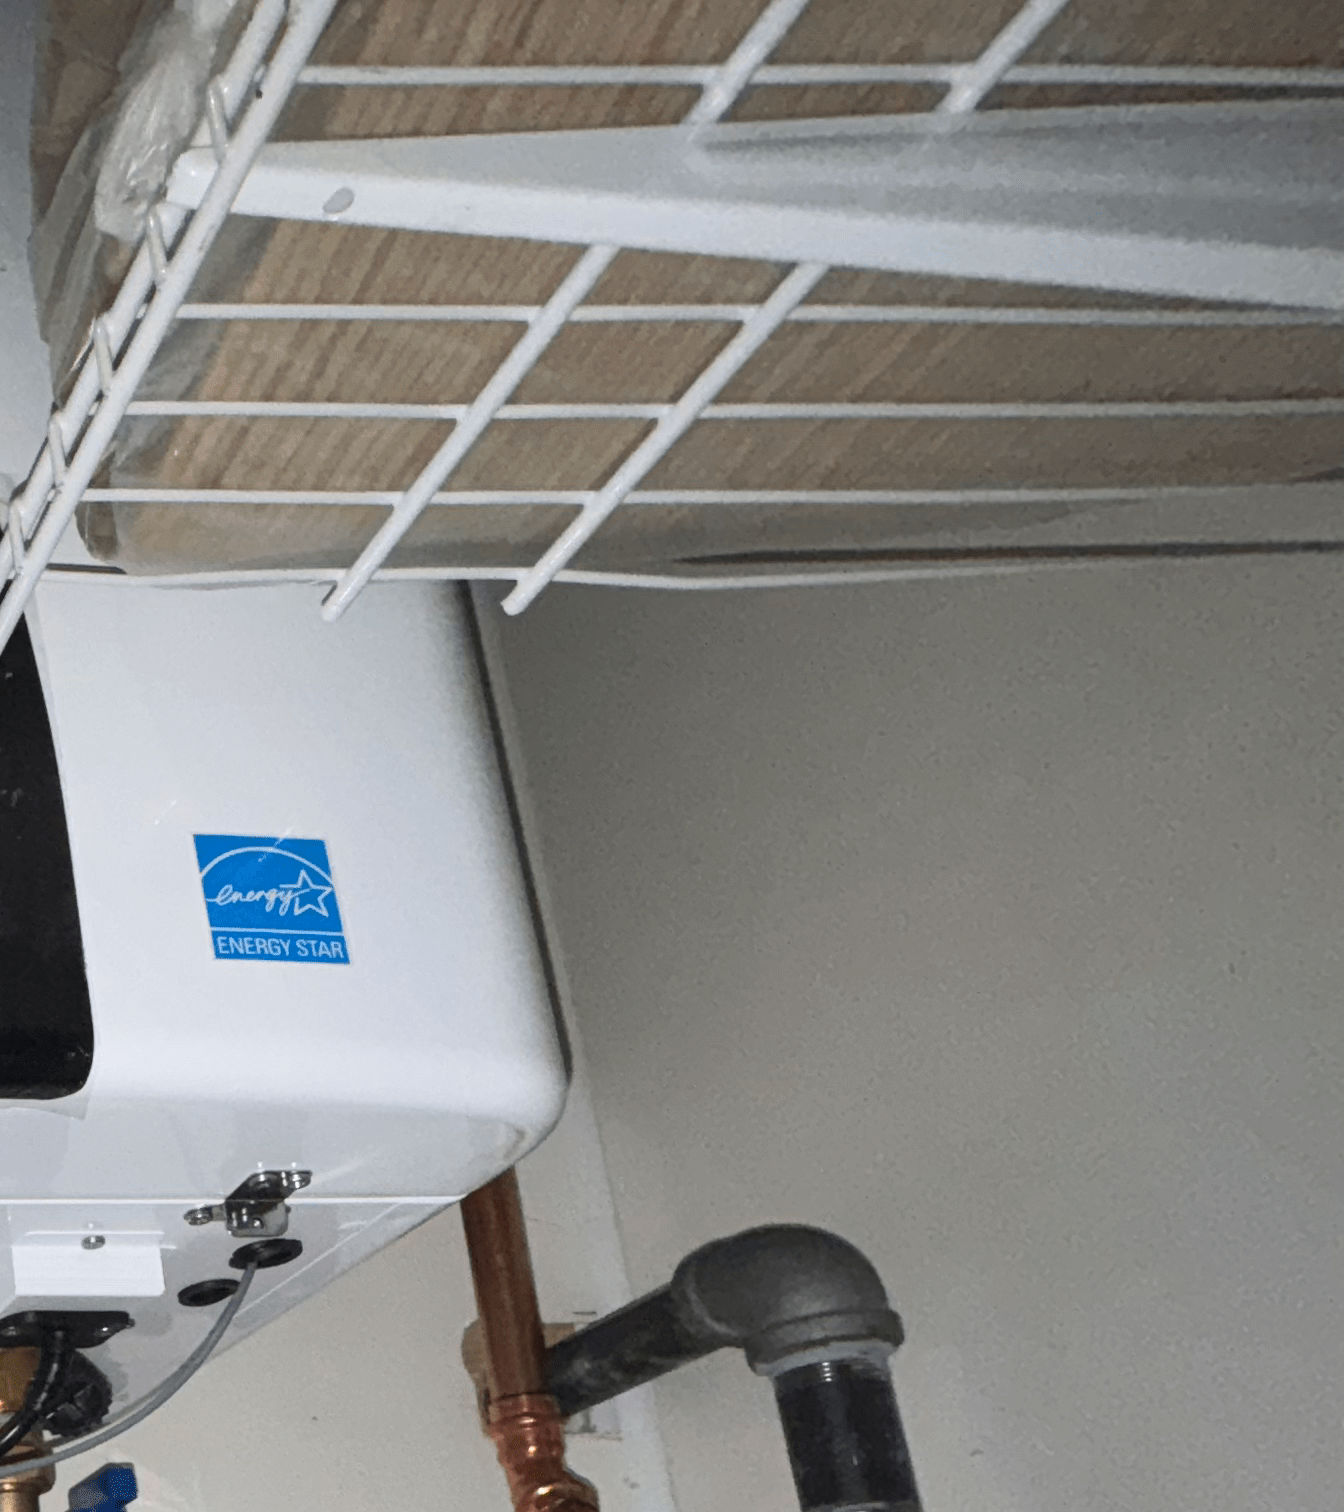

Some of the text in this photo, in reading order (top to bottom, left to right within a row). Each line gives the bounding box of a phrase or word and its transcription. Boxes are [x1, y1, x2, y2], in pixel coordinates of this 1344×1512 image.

[206, 884, 294, 917] energy
[216, 936, 345, 959] ENERGY STAR
